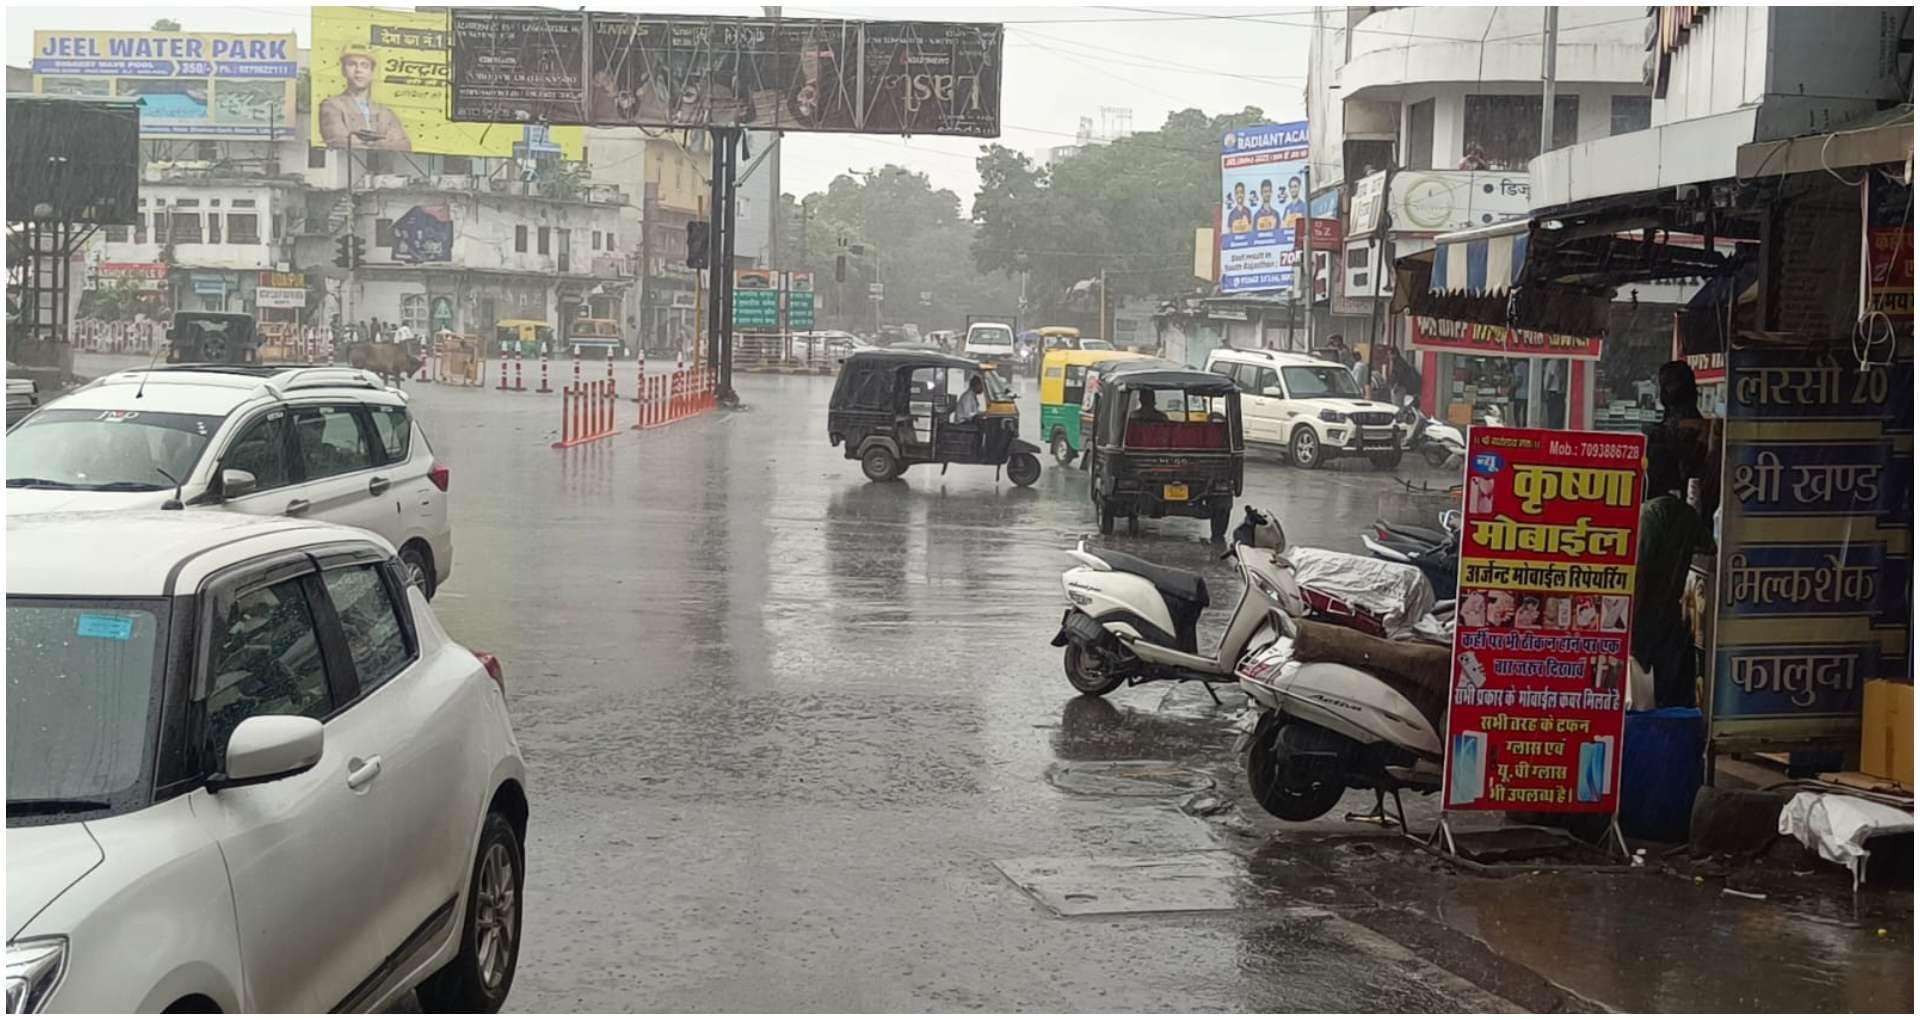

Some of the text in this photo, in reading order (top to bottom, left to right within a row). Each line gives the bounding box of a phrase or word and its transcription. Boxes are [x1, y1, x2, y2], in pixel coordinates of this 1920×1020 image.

[42, 37, 287, 59] JEEL WATER PARK
[900, 73, 980, 112] Last
[1237, 133, 1284, 150] RADIANT
[1735, 353, 1843, 405] लस्सी
[1512, 464, 1636, 514] कृष्णा
[1733, 450, 1884, 504] श्री खण्ड
[1470, 515, 1631, 557] मोबाईल
[1465, 560, 1510, 585] अर्जेन्ट
[1726, 554, 1879, 606] मिल्कशेक
[1729, 653, 1860, 707] फालुदा
[1480, 713, 1509, 732] सभी
[1505, 740, 1542, 755] ग्लास
